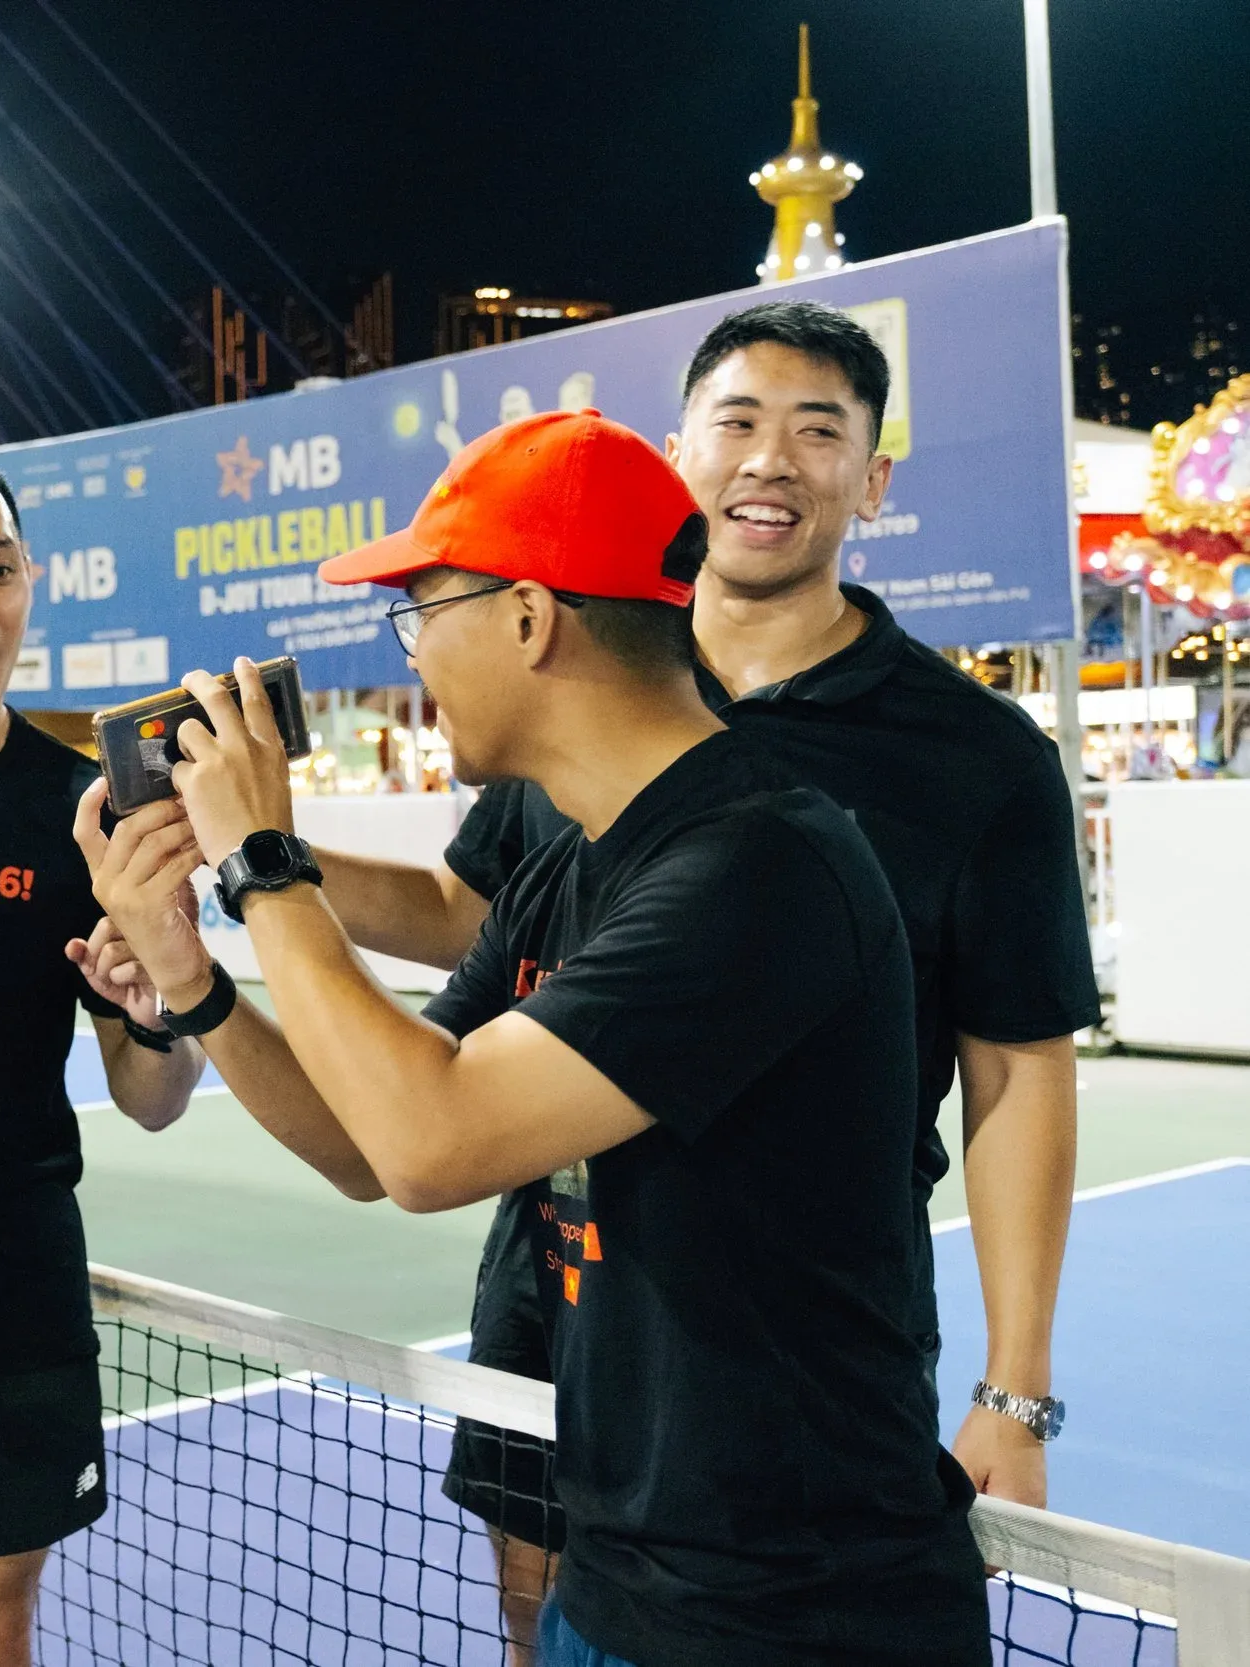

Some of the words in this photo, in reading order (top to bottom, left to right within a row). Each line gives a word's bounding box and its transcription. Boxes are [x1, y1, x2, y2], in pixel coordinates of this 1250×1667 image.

[268, 436, 341, 496] MB
[175, 497, 385, 579] PICKLEBALL
[50, 547, 118, 604] MB
